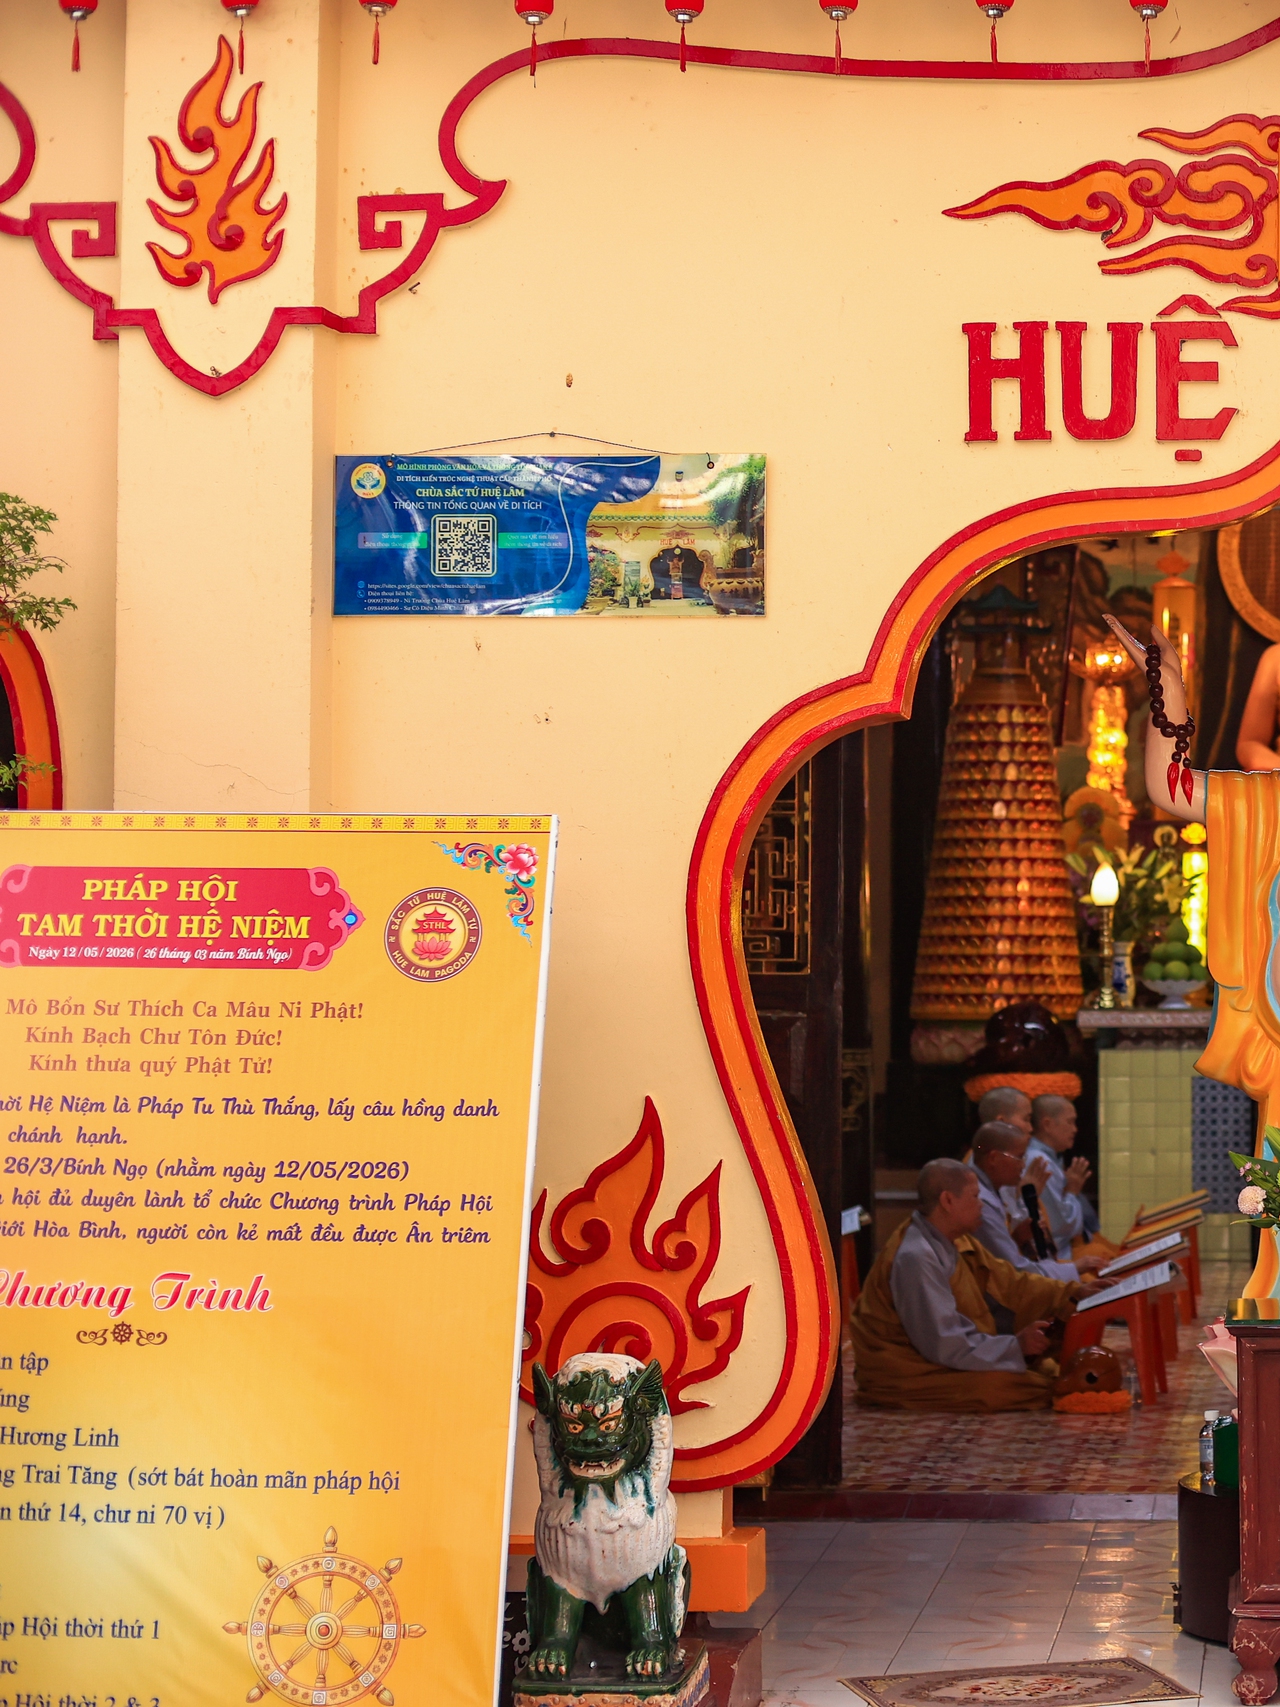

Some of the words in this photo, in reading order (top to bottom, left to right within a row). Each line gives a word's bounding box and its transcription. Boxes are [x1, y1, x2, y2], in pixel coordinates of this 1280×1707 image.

[961, 293, 1239, 462] HUỆ
[393, 500, 425, 510] THÔNG
[426, 502, 441, 510] TIN
[443, 499, 468, 510] TỔNG
[470, 502, 496, 510] QUAN
[498, 500, 509, 510] VỀ
[511, 502, 520, 510] DI
[522, 500, 542, 510] TÍCH
[416, 486, 443, 497] CHÙA
[445, 485, 464, 497] SẮC
[465, 486, 479, 497] TỨ
[481, 486, 501, 499] HUỆ
[503, 486, 525, 497] LÂM
[82, 873, 168, 901] PHÁP
[177, 874, 239, 906] HỘI
[17, 914, 84, 937] TAM
[92, 908, 169, 938] THỜI
[177, 910, 222, 946] HỆ
[229, 910, 311, 946] NIỆM
[28, 946, 60, 960] Ngày
[159, 948, 191, 963] tháng
[194, 949, 207, 960] 03
[209, 949, 234, 960] năm
[392, 950, 409, 968] HUE
[410, 967, 430, 978] LAM
[435, 952, 472, 978] PAGODA
[6, 999, 38, 1016] Mô
[46, 996, 85, 1016] Bổn
[93, 999, 120, 1016] Sư
[128, 999, 184, 1018] Thích
[192, 1000, 217, 1018] Ca
[225, 1001, 270, 1018] Mâu
[279, 1002, 301, 1018] Ni
[310, 1001, 363, 1022] Phật!
[25, 1026, 73, 1044] Kính
[82, 1027, 131, 1047] Bạch
[140, 1028, 180, 1045] Chư
[188, 1029, 227, 1046] Tôn
[236, 1029, 282, 1046] Đức!
[28, 1054, 77, 1072] Kính
[86, 1055, 131, 1072] thưa
[139, 1056, 177, 1077] quý
[184, 1056, 231, 1077] Phật
[239, 1057, 272, 1074] Tử!
[29, 1095, 54, 1115] Hệ
[59, 1095, 106, 1116] Niệm
[112, 1095, 131, 1113] là
[137, 1096, 184, 1119] Pháp
[192, 1097, 215, 1114] Tu
[222, 1097, 255, 1114] Thù
[262, 1096, 319, 1120] Thắng,
[328, 1097, 355, 1121] lấy
[362, 1101, 396, 1117] câu
[402, 1098, 445, 1122] hồng
[453, 1099, 500, 1117] danh
[8, 1125, 63, 1143] chánh
[76, 1126, 128, 1147] hạnh.
[4, 1156, 106, 1177] 26/3/Bính
[112, 1158, 148, 1181] Ngọ
[156, 1157, 216, 1179] (nhằm
[223, 1162, 266, 1184] ngày
[274, 1160, 410, 1182] 12/05/2026)
[151, 1272, 273, 1312] Trình
[0, 1426, 67, 1451] Hương
[73, 1428, 120, 1448] Linh
[22, 1464, 61, 1485] Trai
[67, 1465, 117, 1490] Tăng
[174, 1467, 204, 1487] bát
[210, 1468, 258, 1489] hoàn
[265, 1471, 307, 1490] mãn
[313, 1470, 362, 1495] pháp
[368, 1470, 400, 1492] hội
[21, 1617, 58, 1640] Hội
[65, 1617, 104, 1638] thời
[111, 1619, 144, 1639] thứ
[151, 1620, 159, 1639] 1
